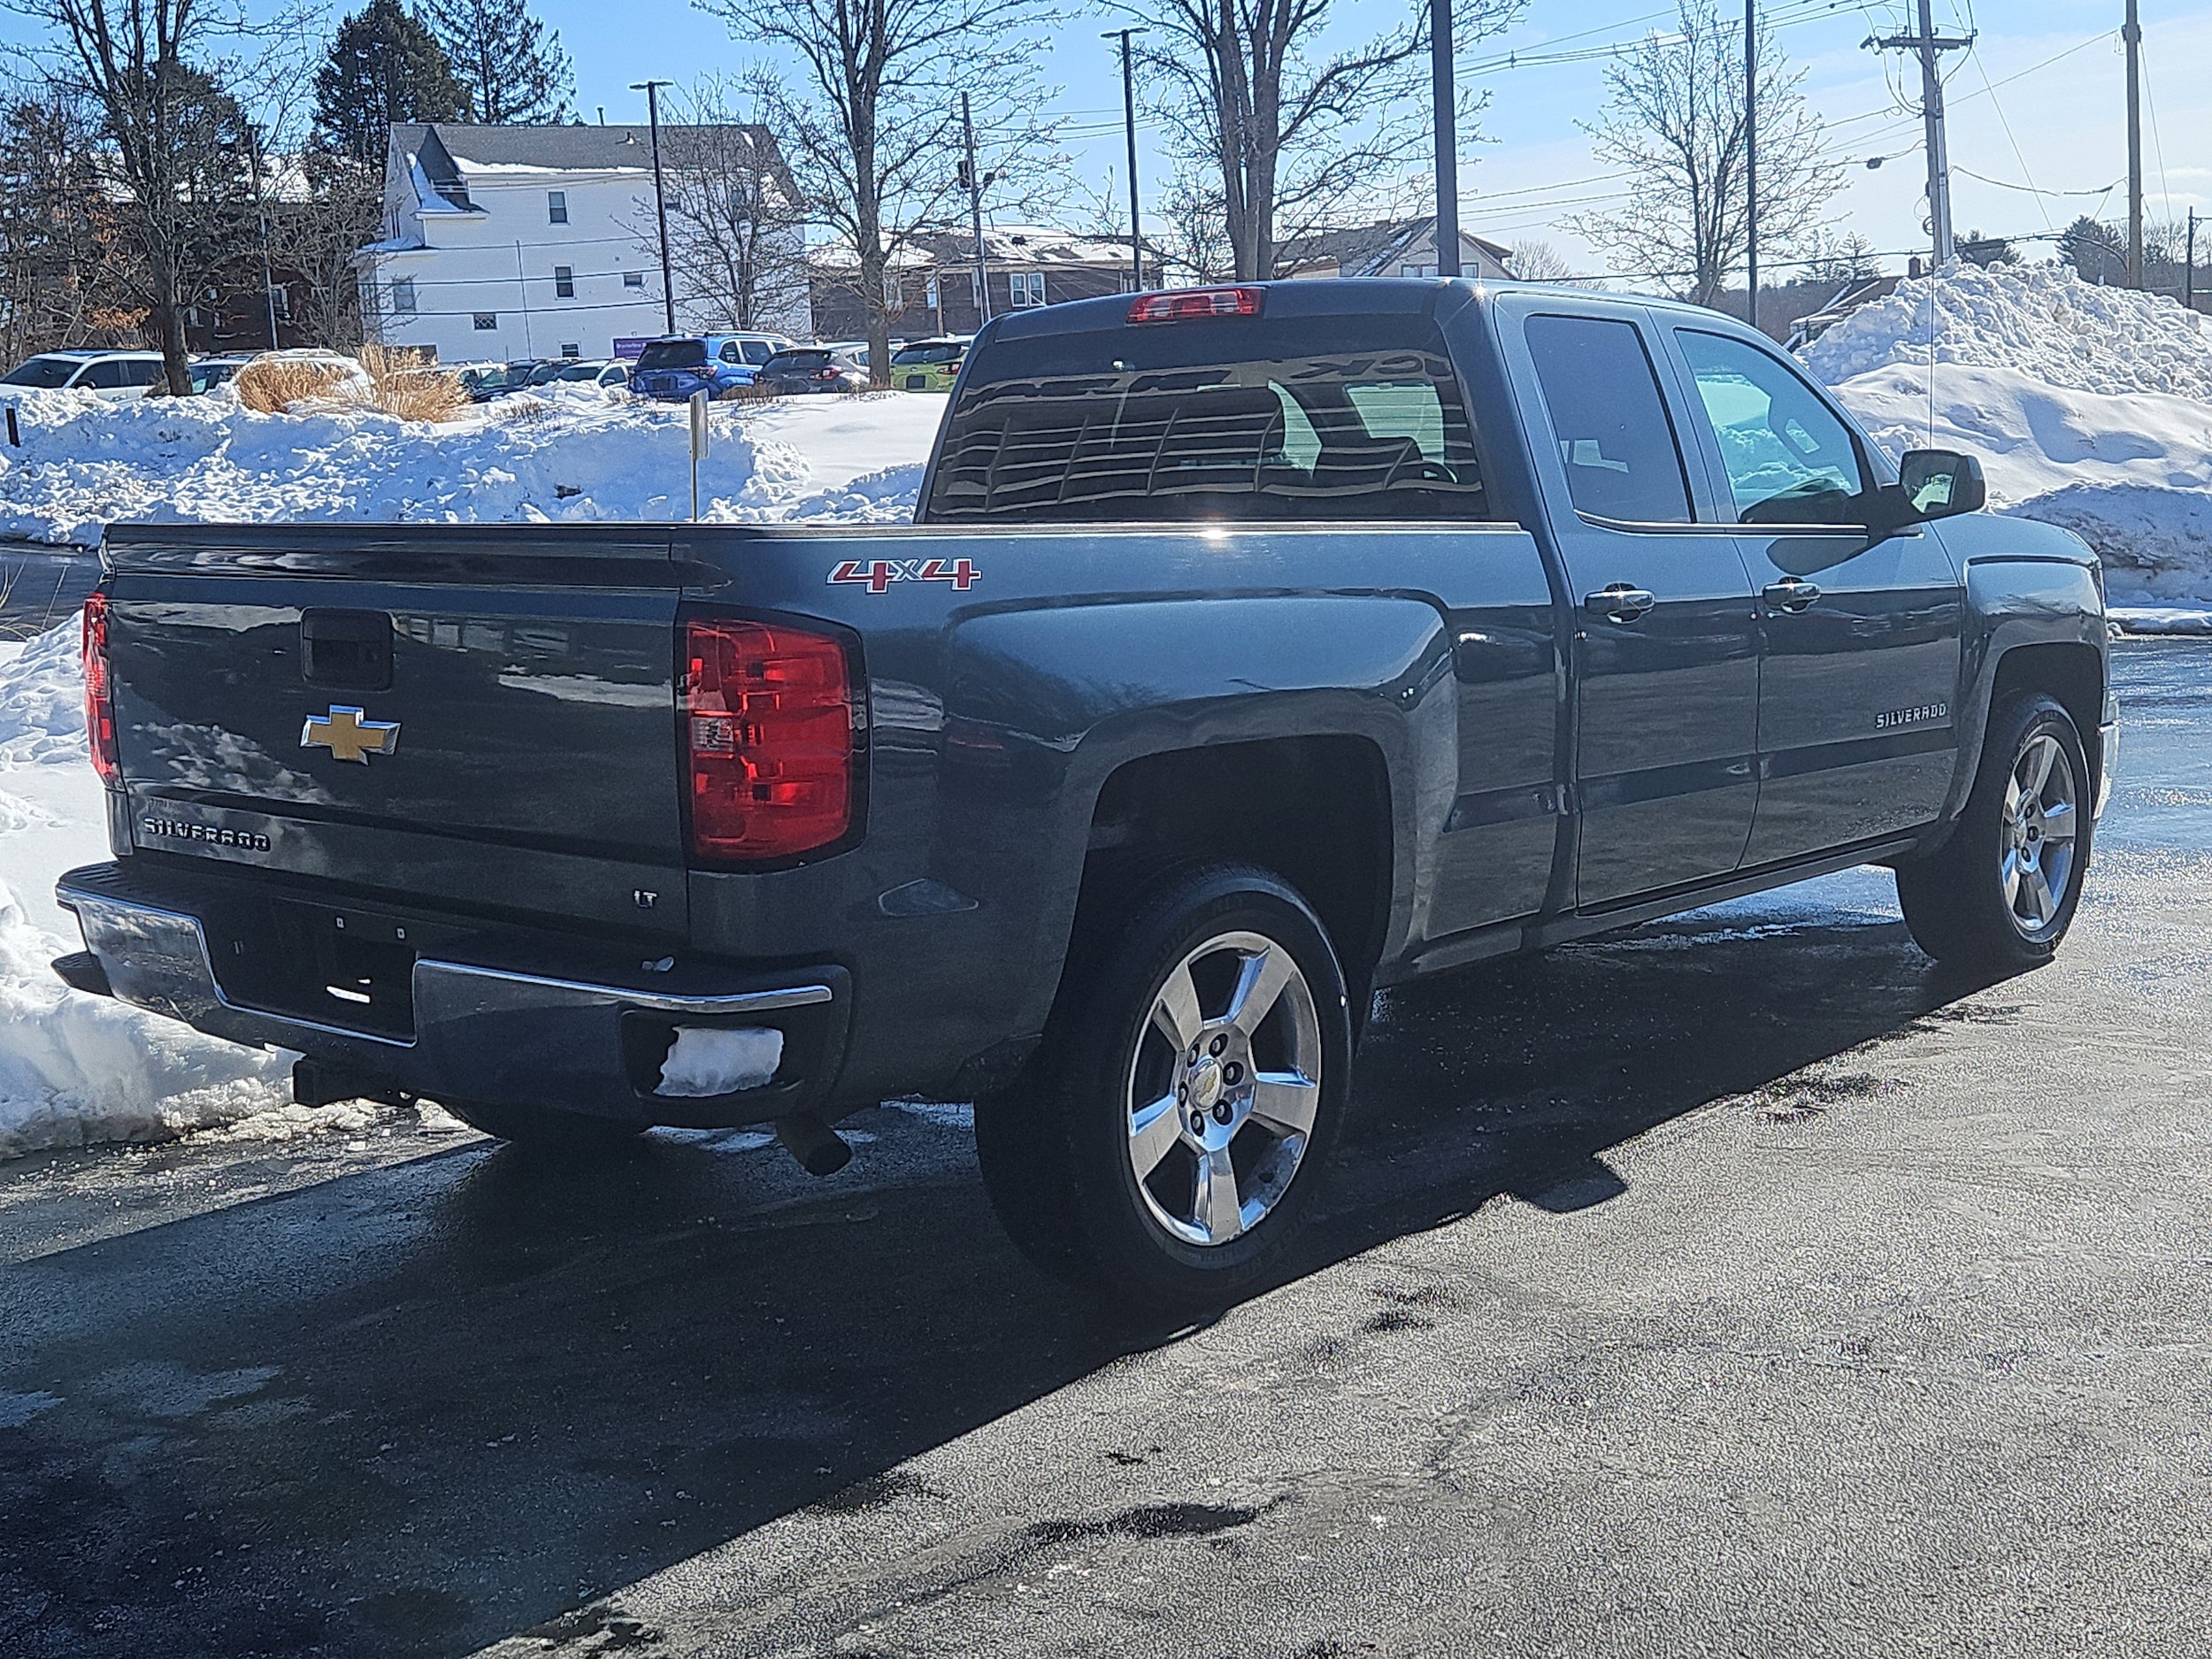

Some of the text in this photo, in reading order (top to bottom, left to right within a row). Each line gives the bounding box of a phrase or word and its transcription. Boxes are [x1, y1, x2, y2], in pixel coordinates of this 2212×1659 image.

[1875, 702, 1947, 729] SILVERADO
[142, 816, 271, 852] SILVERADO
[633, 889, 658, 908] LT
